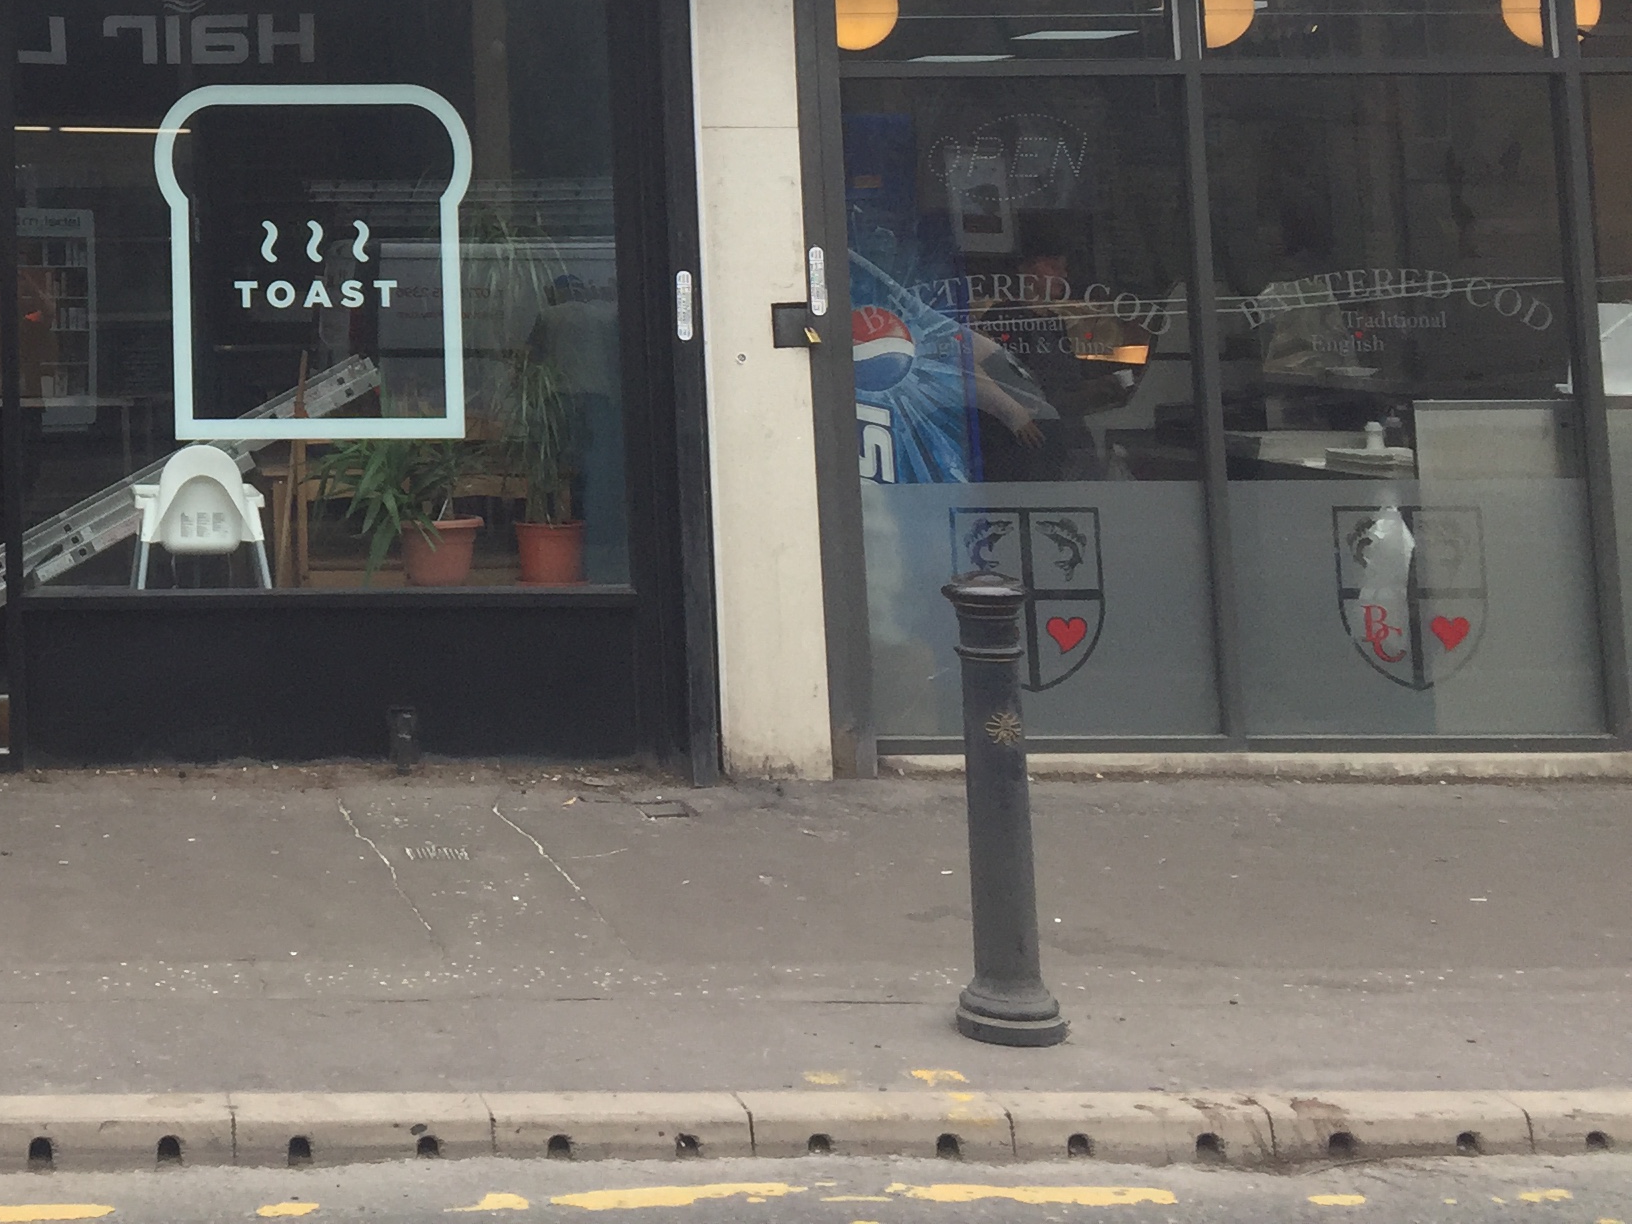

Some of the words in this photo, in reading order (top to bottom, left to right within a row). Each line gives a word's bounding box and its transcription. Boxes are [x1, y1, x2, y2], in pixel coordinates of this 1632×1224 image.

[927, 135, 1087, 178] OPEN
[233, 280, 398, 309] TOAST
[1238, 268, 1453, 330] BATTERED
[1466, 278, 1555, 331] COD
[1083, 282, 1172, 337] COD
[1342, 310, 1447, 329] Traditional
[1036, 337, 1052, 354] &
[1310, 333, 1386, 354] English
